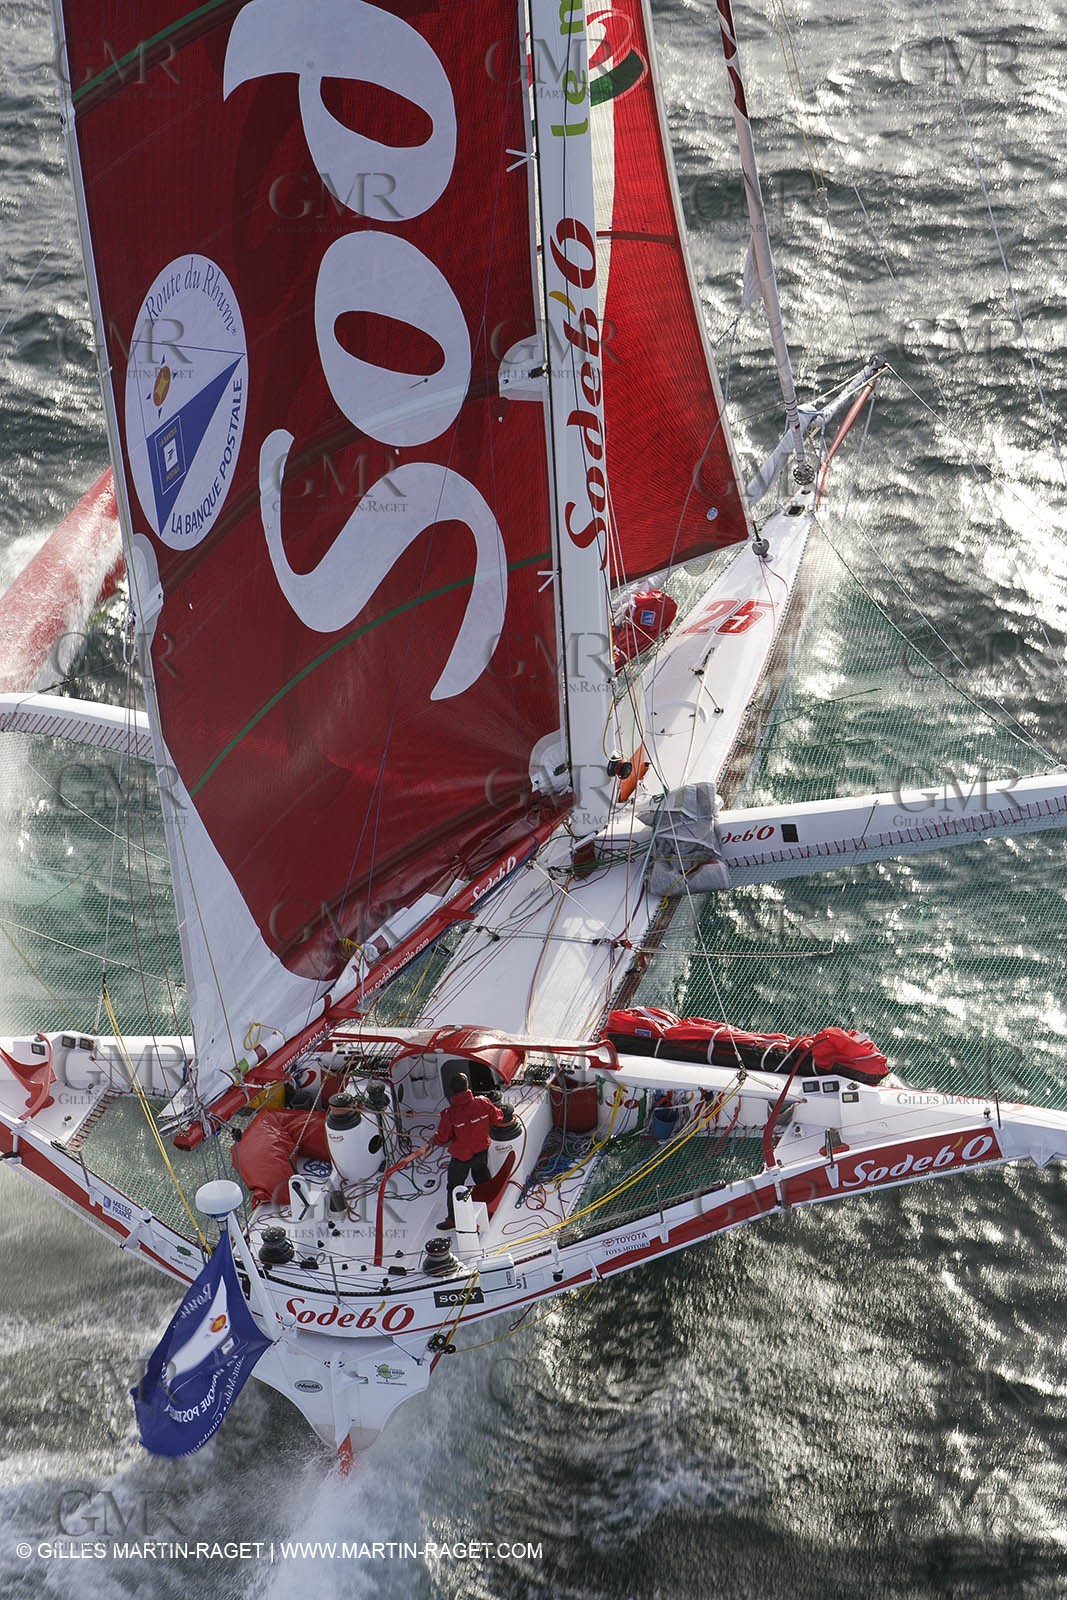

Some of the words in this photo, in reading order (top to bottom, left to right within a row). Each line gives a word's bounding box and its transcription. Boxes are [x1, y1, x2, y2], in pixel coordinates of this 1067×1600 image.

[145, 276, 182, 327] Route
[184, 257, 201, 290] du
[549, 217, 608, 571] Sodeb'O
[171, 512, 183, 535] LA
[184, 477, 222, 535] BANQUE
[218, 378, 243, 482] POSTALE
[677, 598, 780, 636] 25
[842, 1134, 993, 1188] Sodeb'O
[615, 1232, 648, 1244] TOYOTA
[275, 1297, 415, 1334] Sodeb'O
[439, 1291, 478, 1304] SONY
